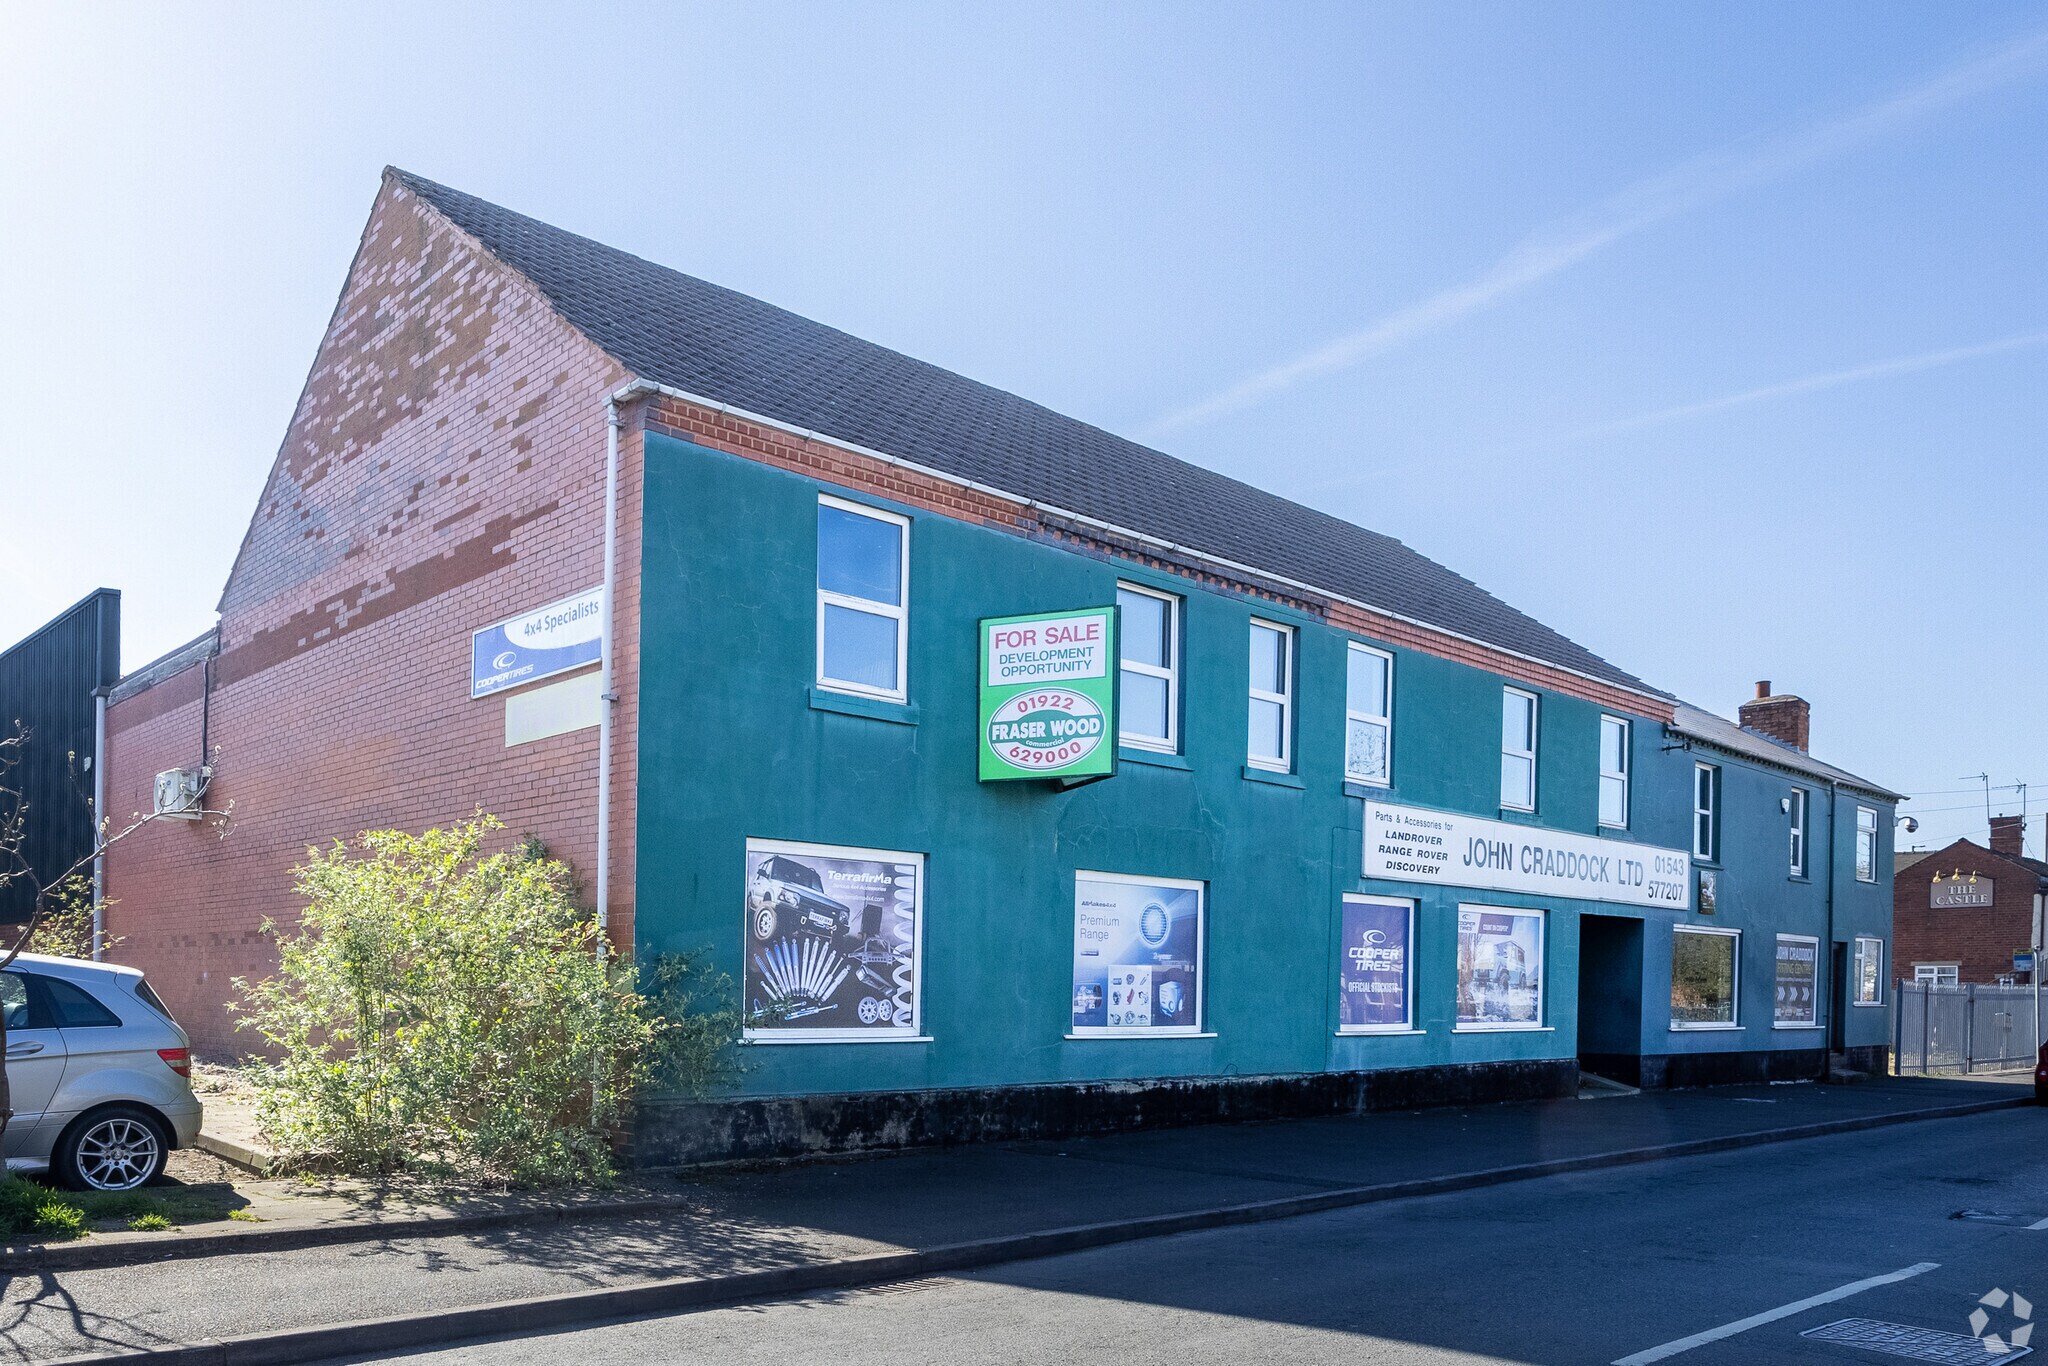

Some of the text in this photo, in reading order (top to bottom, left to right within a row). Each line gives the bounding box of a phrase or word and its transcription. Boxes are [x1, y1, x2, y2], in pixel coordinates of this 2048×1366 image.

[524, 601, 599, 637] 4x4 Specialists
[995, 623, 1100, 649] FOR SALE
[999, 646, 1094, 665] DEVELOPMENT
[1001, 659, 1092, 678] OPPORTUNITY
[1017, 694, 1074, 713] 01922
[991, 717, 1100, 741] FRASER WOOD
[1025, 737, 1065, 747] commercial
[1009, 741, 1081, 763] 629000
[1375, 811, 1454, 831] Parts & Accessories for
[1385, 830, 1443, 846] LANDROVER
[1378, 844, 1448, 861] RANGE ROVER
[1463, 836, 1644, 887] JOHN CRADDOCK LTD
[1385, 860, 1441, 875] DISCOVERY
[1654, 855, 1685, 876] 01543
[1647, 880, 1684, 901] 577207
[1947, 885, 1976, 895] THE
[1935, 894, 1988, 906] CASTLE
[1080, 913, 1120, 927] Premium
[1080, 927, 1109, 942] Range
[1348, 947, 1399, 960] COOPER
[1355, 960, 1391, 971] TIRES
[1348, 981, 1371, 993] OFFICIAL
